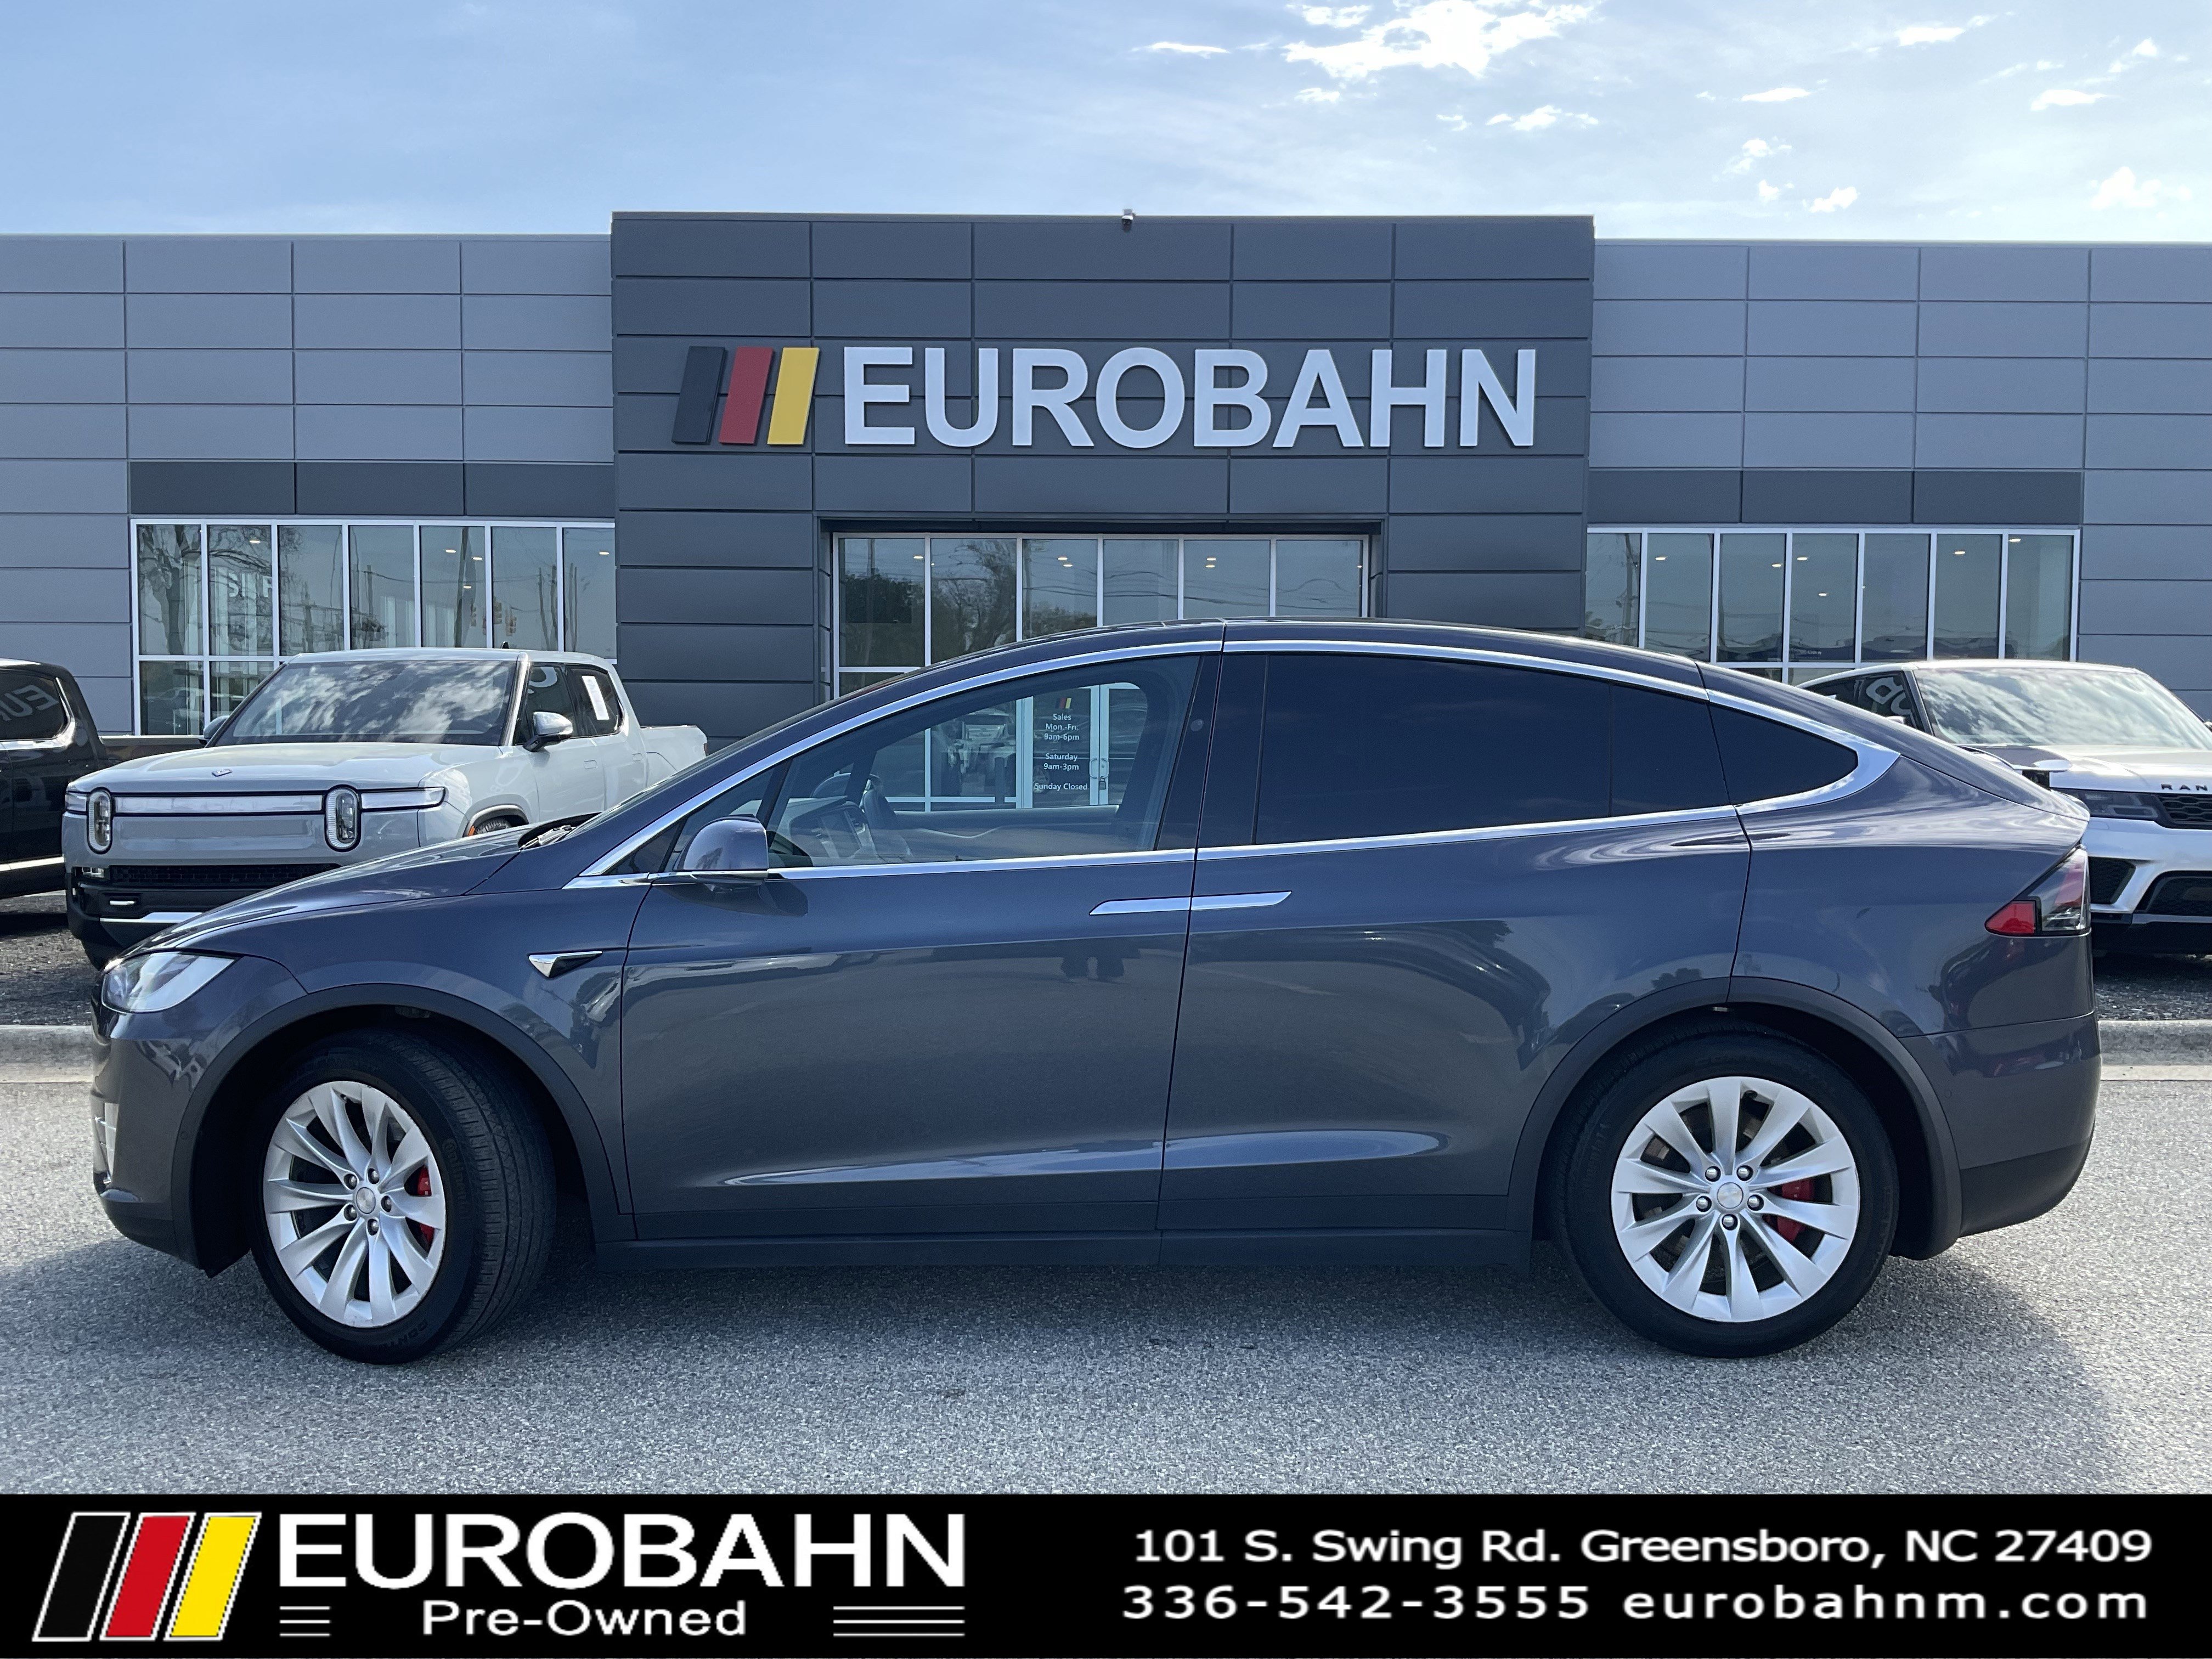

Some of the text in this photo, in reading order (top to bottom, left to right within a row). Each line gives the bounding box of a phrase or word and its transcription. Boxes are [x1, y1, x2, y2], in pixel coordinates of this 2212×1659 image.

[843, 346, 1536, 449] EUROBAHN
[1044, 733, 1080, 741] 9am-6pm
[1043, 763, 1079, 771] 9am-3pm
[1034, 782, 1062, 791] Sunday
